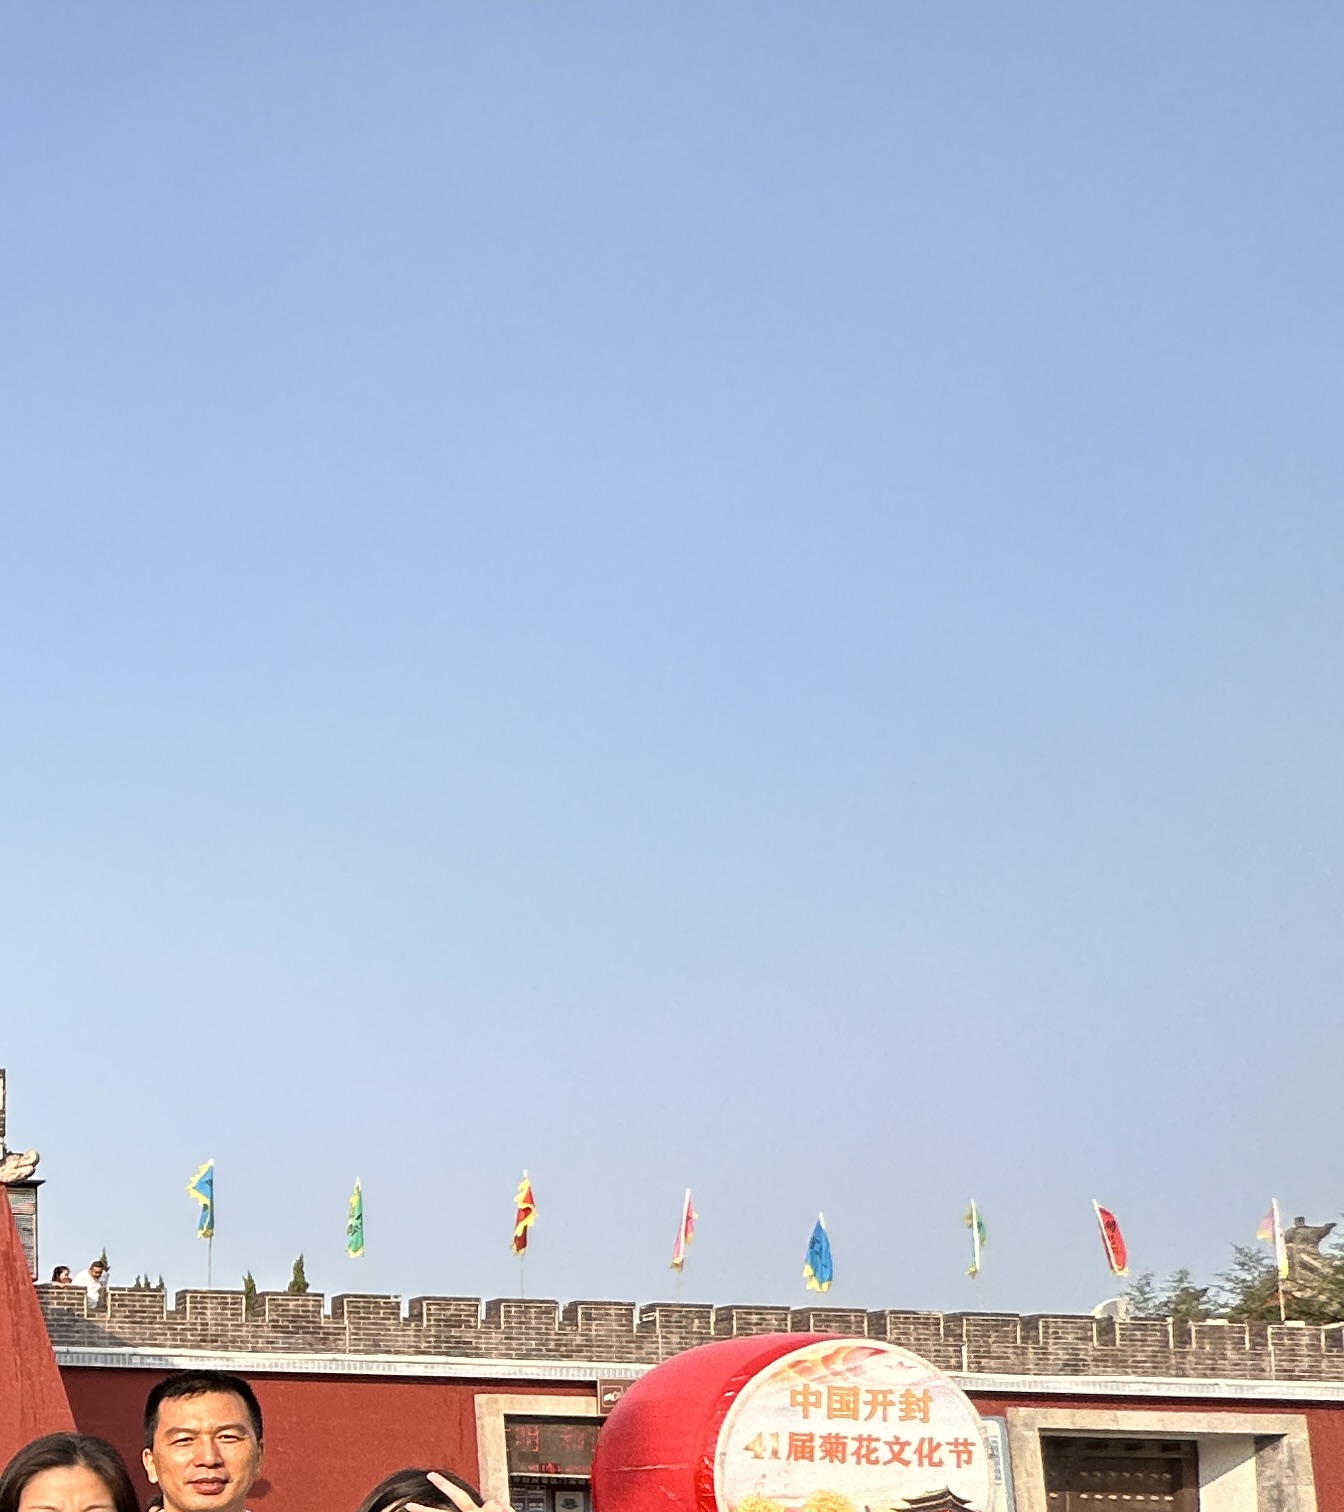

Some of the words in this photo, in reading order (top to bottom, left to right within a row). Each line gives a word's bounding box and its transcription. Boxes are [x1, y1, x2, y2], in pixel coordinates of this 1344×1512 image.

[789, 1383, 934, 1424] 中国开封
[742, 1430, 977, 1469] 41届菊花文化节
